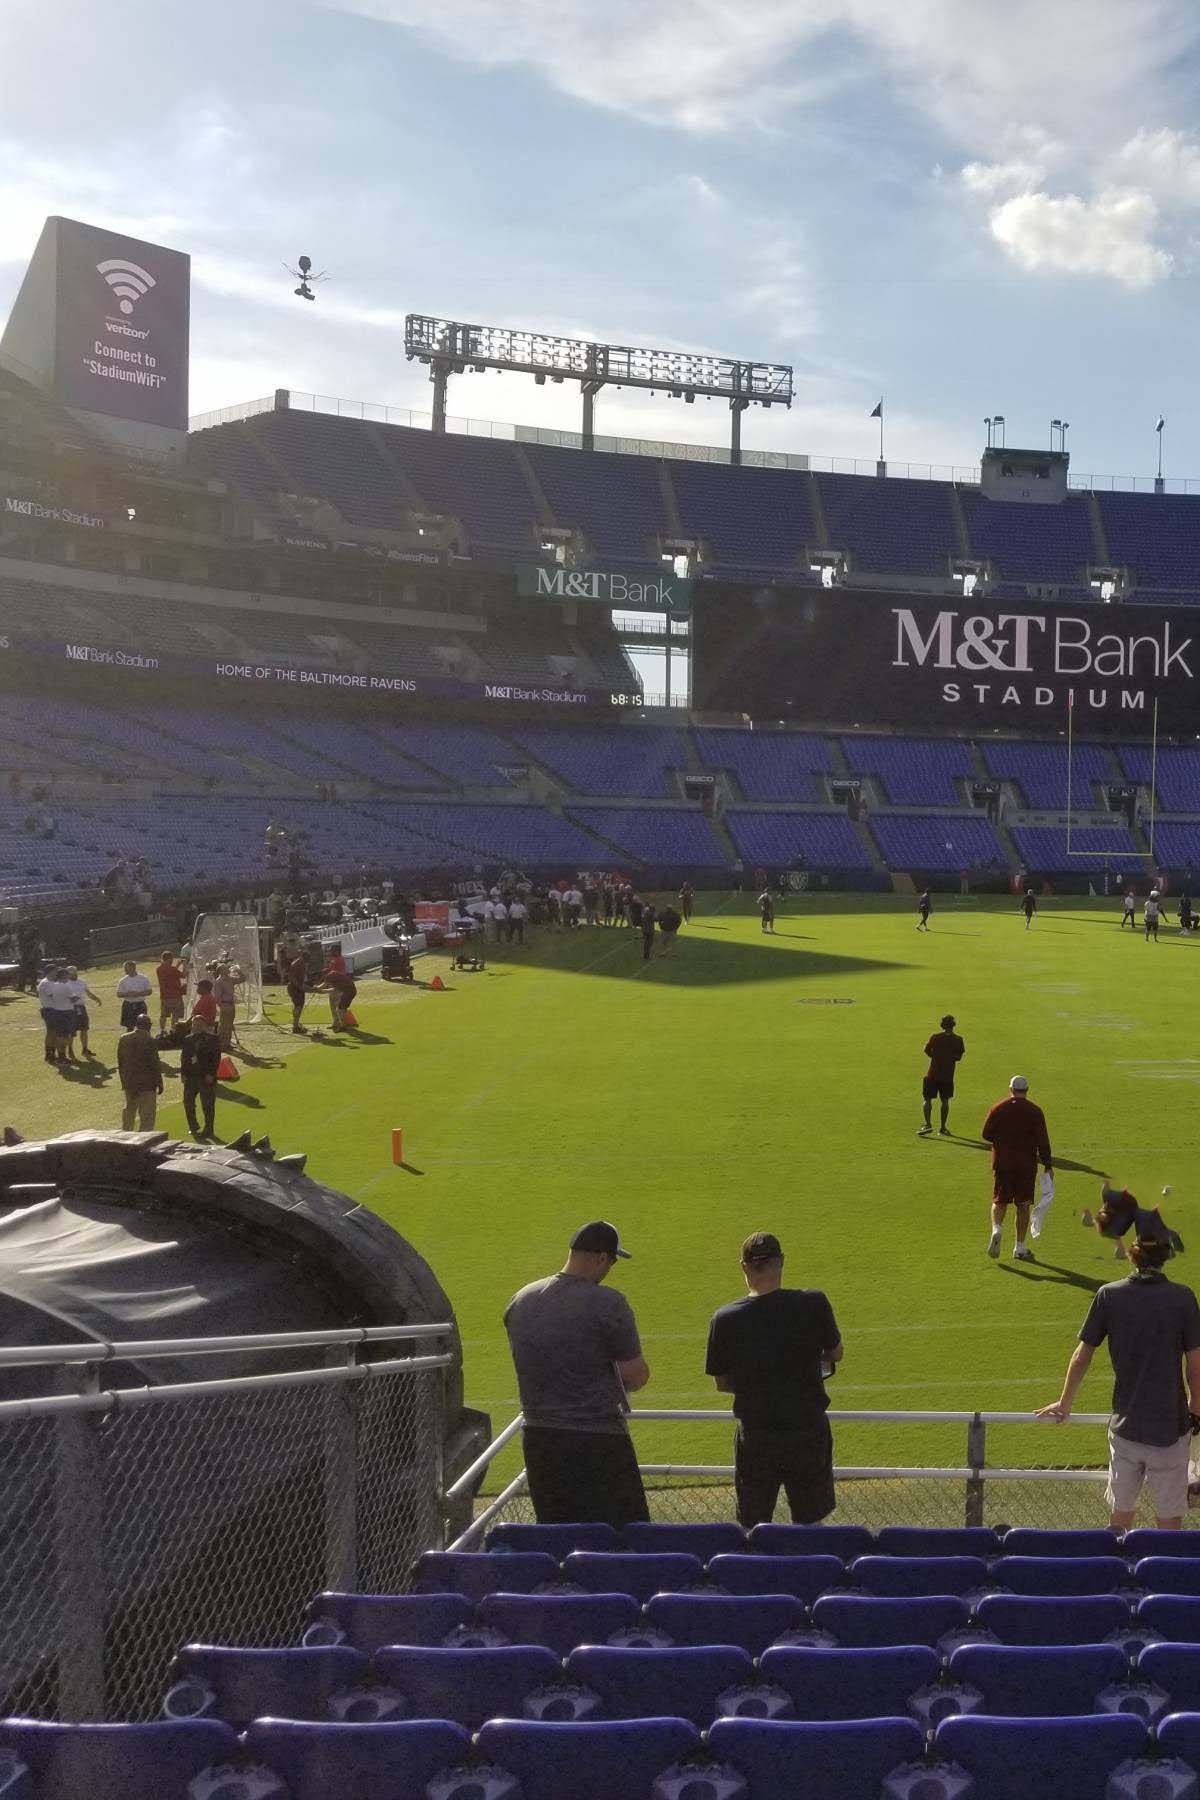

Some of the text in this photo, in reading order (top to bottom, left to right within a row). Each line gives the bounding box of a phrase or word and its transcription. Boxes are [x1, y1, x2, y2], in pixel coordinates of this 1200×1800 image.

[105, 322, 148, 339] verizon
[95, 341, 156, 368] Connect to
[5, 498, 104, 529] M&T Bank Stadium
[535, 567, 675, 605] M&T Bank
[891, 607, 1194, 679] M&T Bank
[66, 644, 159, 669] M&T Bank Stadium
[216, 663, 416, 691] HOME OF THE BALTIMORE RAVENS
[485, 685, 587, 704] M&T Bank Stadium
[942, 683, 1145, 709] STADIUM
[686, 775, 714, 783] GEICO
[832, 779, 860, 788] GEICO
